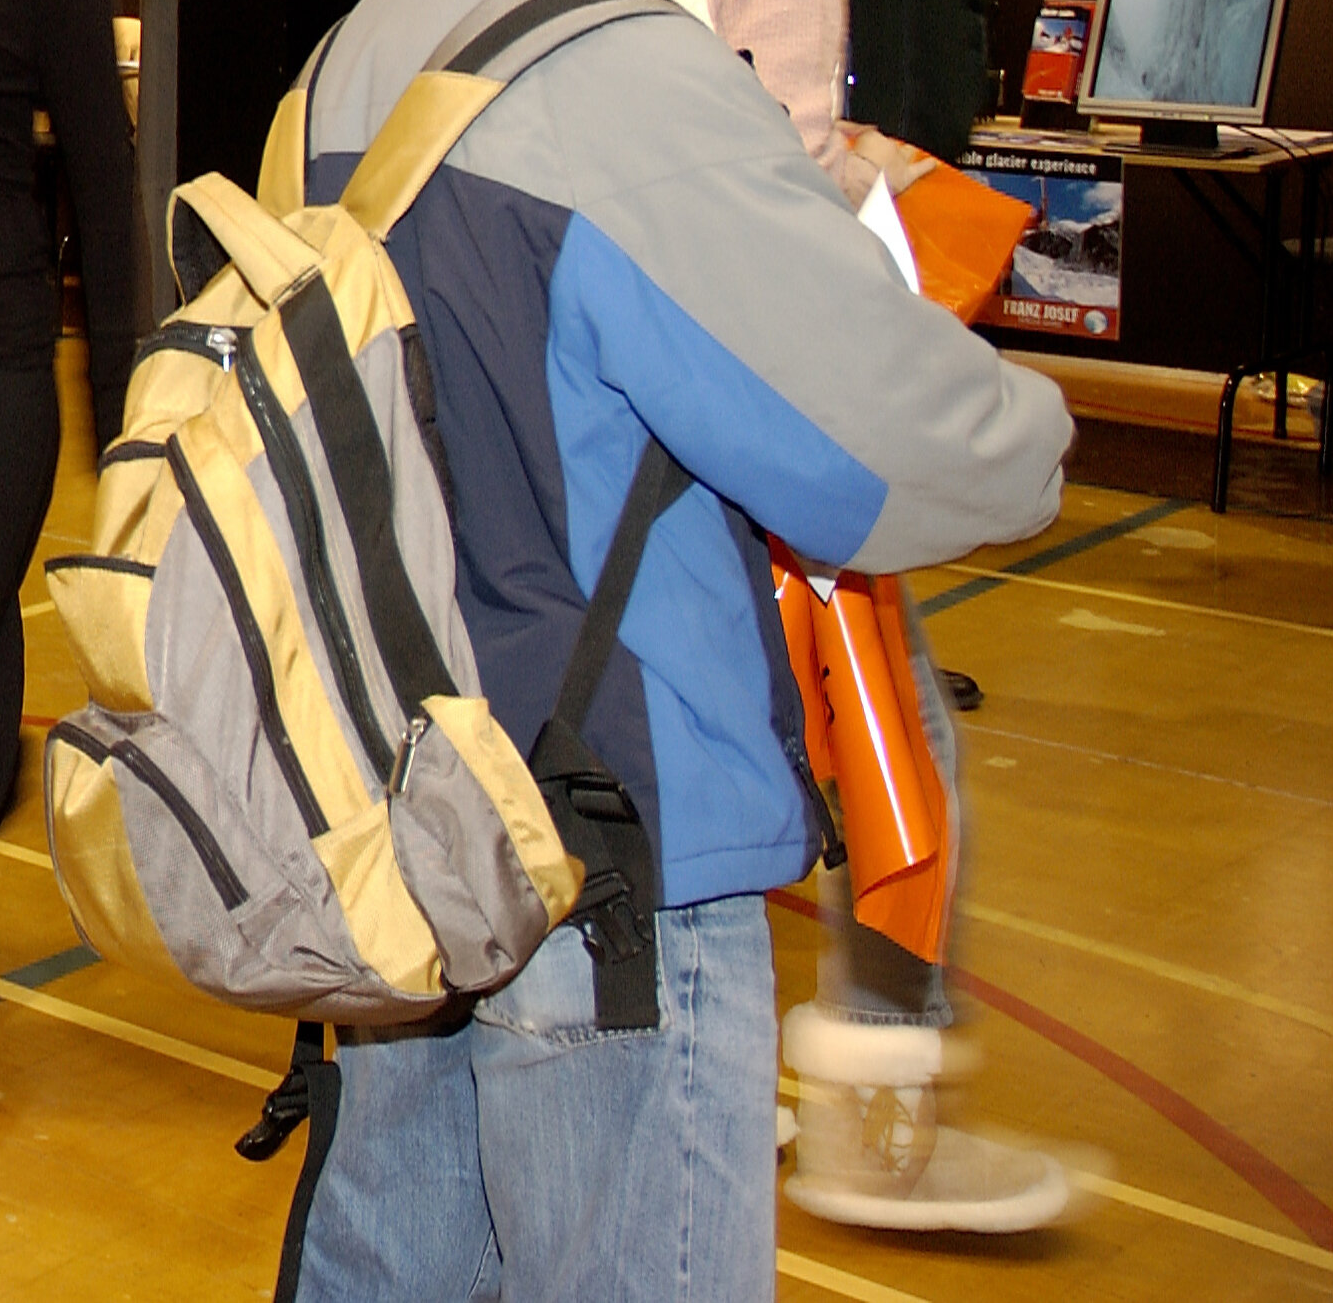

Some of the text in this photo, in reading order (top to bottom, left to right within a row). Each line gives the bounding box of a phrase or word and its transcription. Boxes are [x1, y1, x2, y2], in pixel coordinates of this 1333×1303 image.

[985, 153, 1027, 169] glacier
[1030, 158, 1097, 175] experience
[1003, 299, 1040, 319] FRANZ
[1043, 304, 1080, 323] JOSEF
